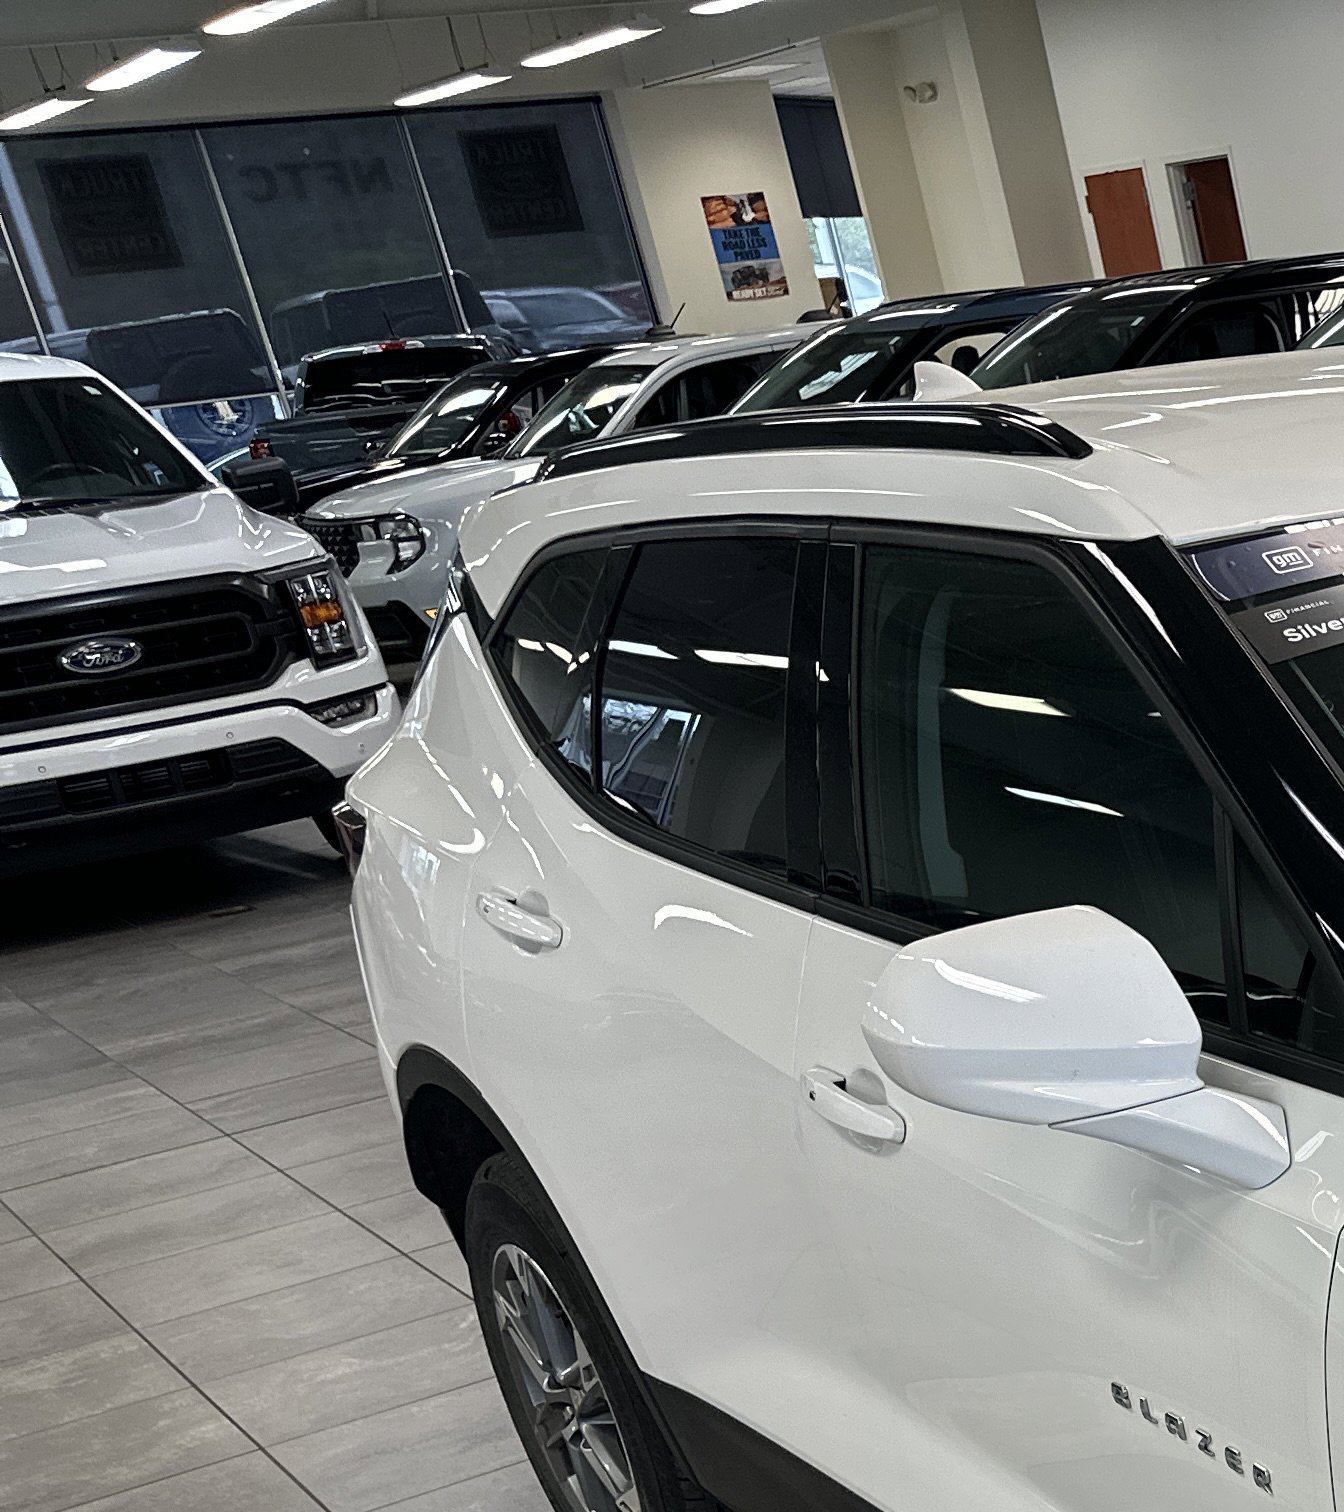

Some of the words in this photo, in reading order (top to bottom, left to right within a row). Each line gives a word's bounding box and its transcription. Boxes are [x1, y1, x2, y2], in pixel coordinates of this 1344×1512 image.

[722, 240, 748, 251] ROAD
[748, 238, 767, 248] LESS
[734, 250, 761, 260] PAVED
[1271, 550, 1303, 569] gm
[1286, 600, 1330, 615] FINANCIAL
[79, 649, 125, 667] Ford
[1110, 1381, 1274, 1496] BLAZER
